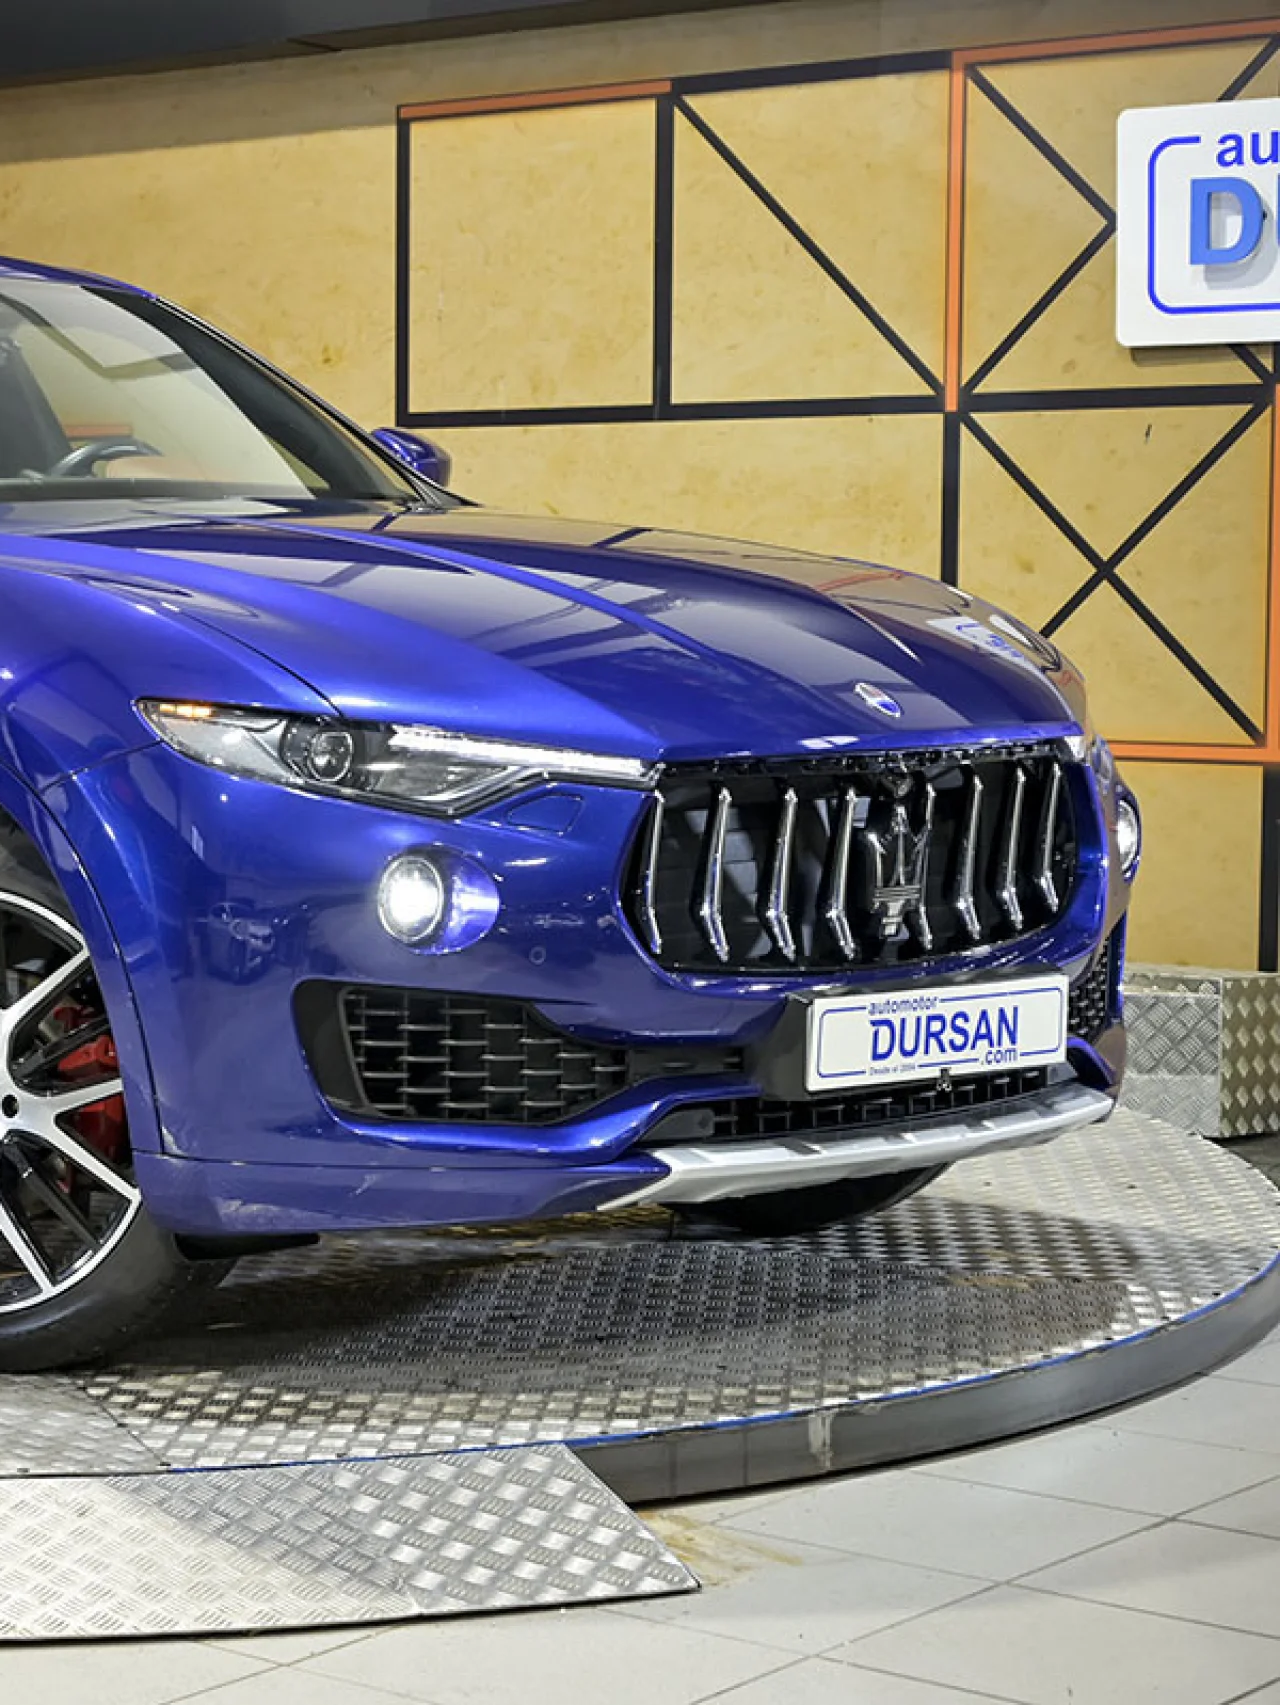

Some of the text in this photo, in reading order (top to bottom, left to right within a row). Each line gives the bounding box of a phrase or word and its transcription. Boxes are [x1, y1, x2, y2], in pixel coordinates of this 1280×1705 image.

[1190, 174, 1280, 265] D
[869, 996, 938, 1015] automotor
[870, 1005, 1019, 1061] DURSAN
[981, 1048, 1018, 1066] .com
